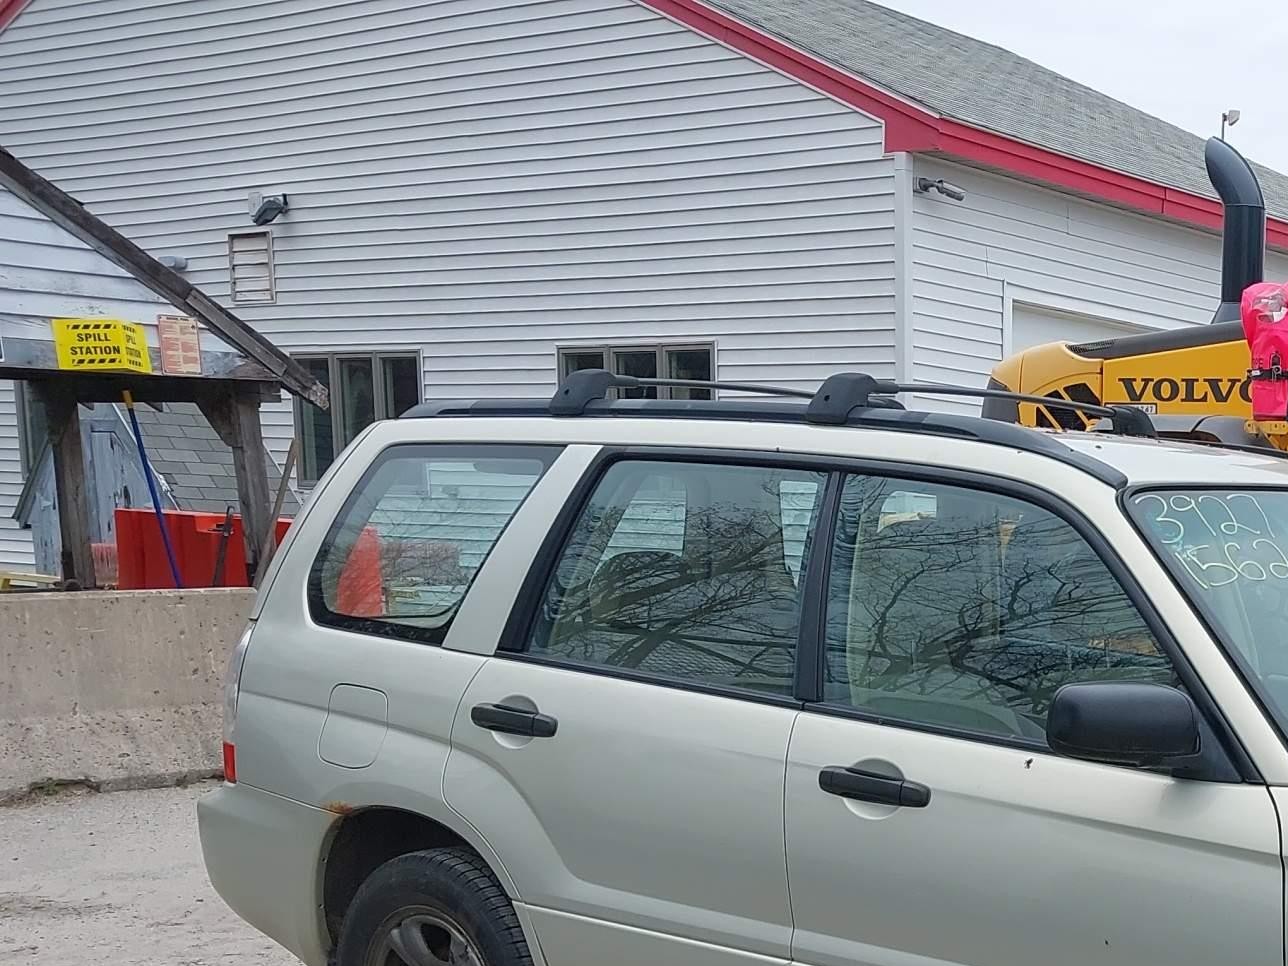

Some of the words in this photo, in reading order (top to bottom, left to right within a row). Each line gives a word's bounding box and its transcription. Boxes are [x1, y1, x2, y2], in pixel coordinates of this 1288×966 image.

[76, 332, 111, 342] SPILL
[70, 345, 121, 356] STATION
[1135, 493, 1276, 544] 3927
